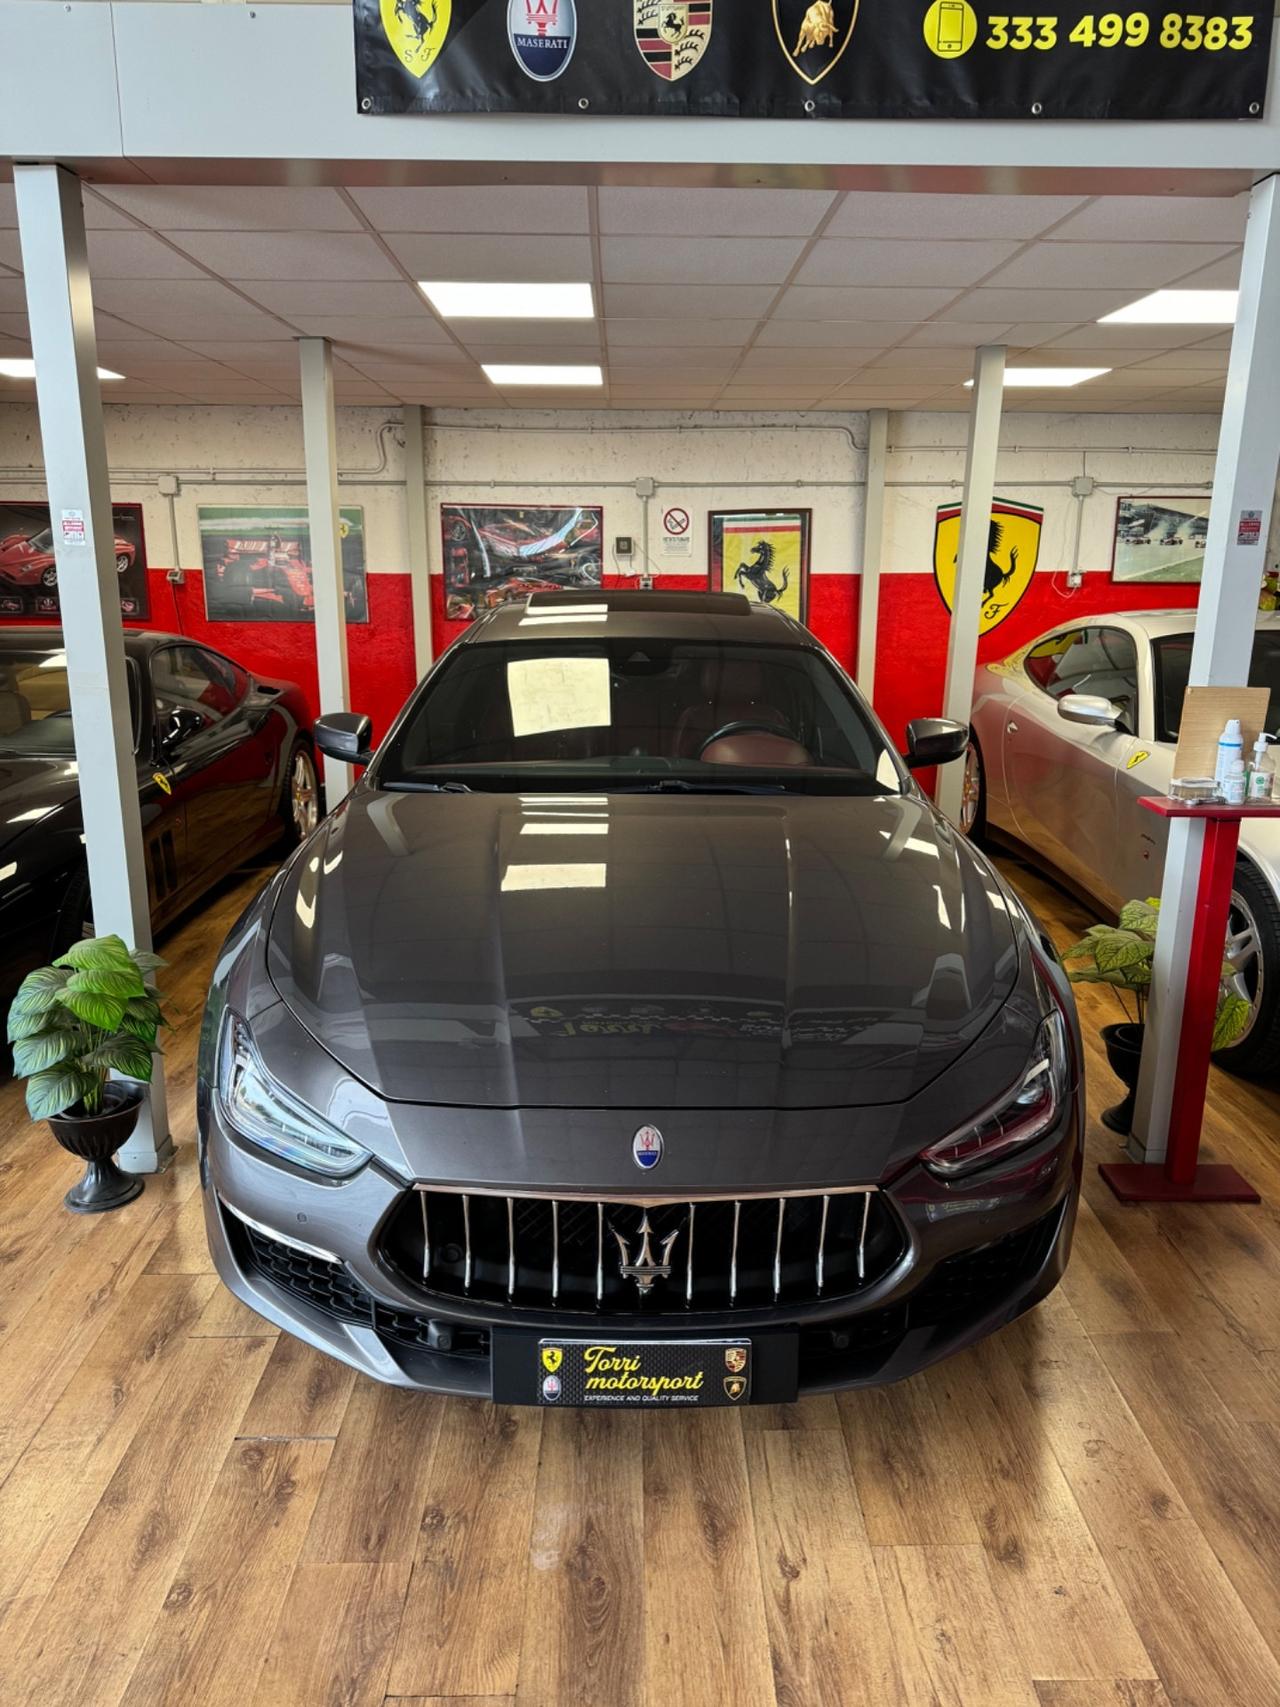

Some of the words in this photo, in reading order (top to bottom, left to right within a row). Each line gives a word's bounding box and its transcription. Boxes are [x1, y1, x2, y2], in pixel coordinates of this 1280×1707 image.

[517, 37, 568, 49] MASERATI
[986, 16, 1058, 50] 333
[1068, 12, 1151, 48] 499
[1160, 13, 1254, 50] 8383
[584, 1346, 641, 1373] Torri
[585, 1371, 704, 1396] motorsport
[584, 1394, 625, 1402] EXPERIENCE
[626, 1394, 641, 1402] AND
[642, 1394, 669, 1402] QUALITY
[671, 1394, 699, 1402] SERVICE
